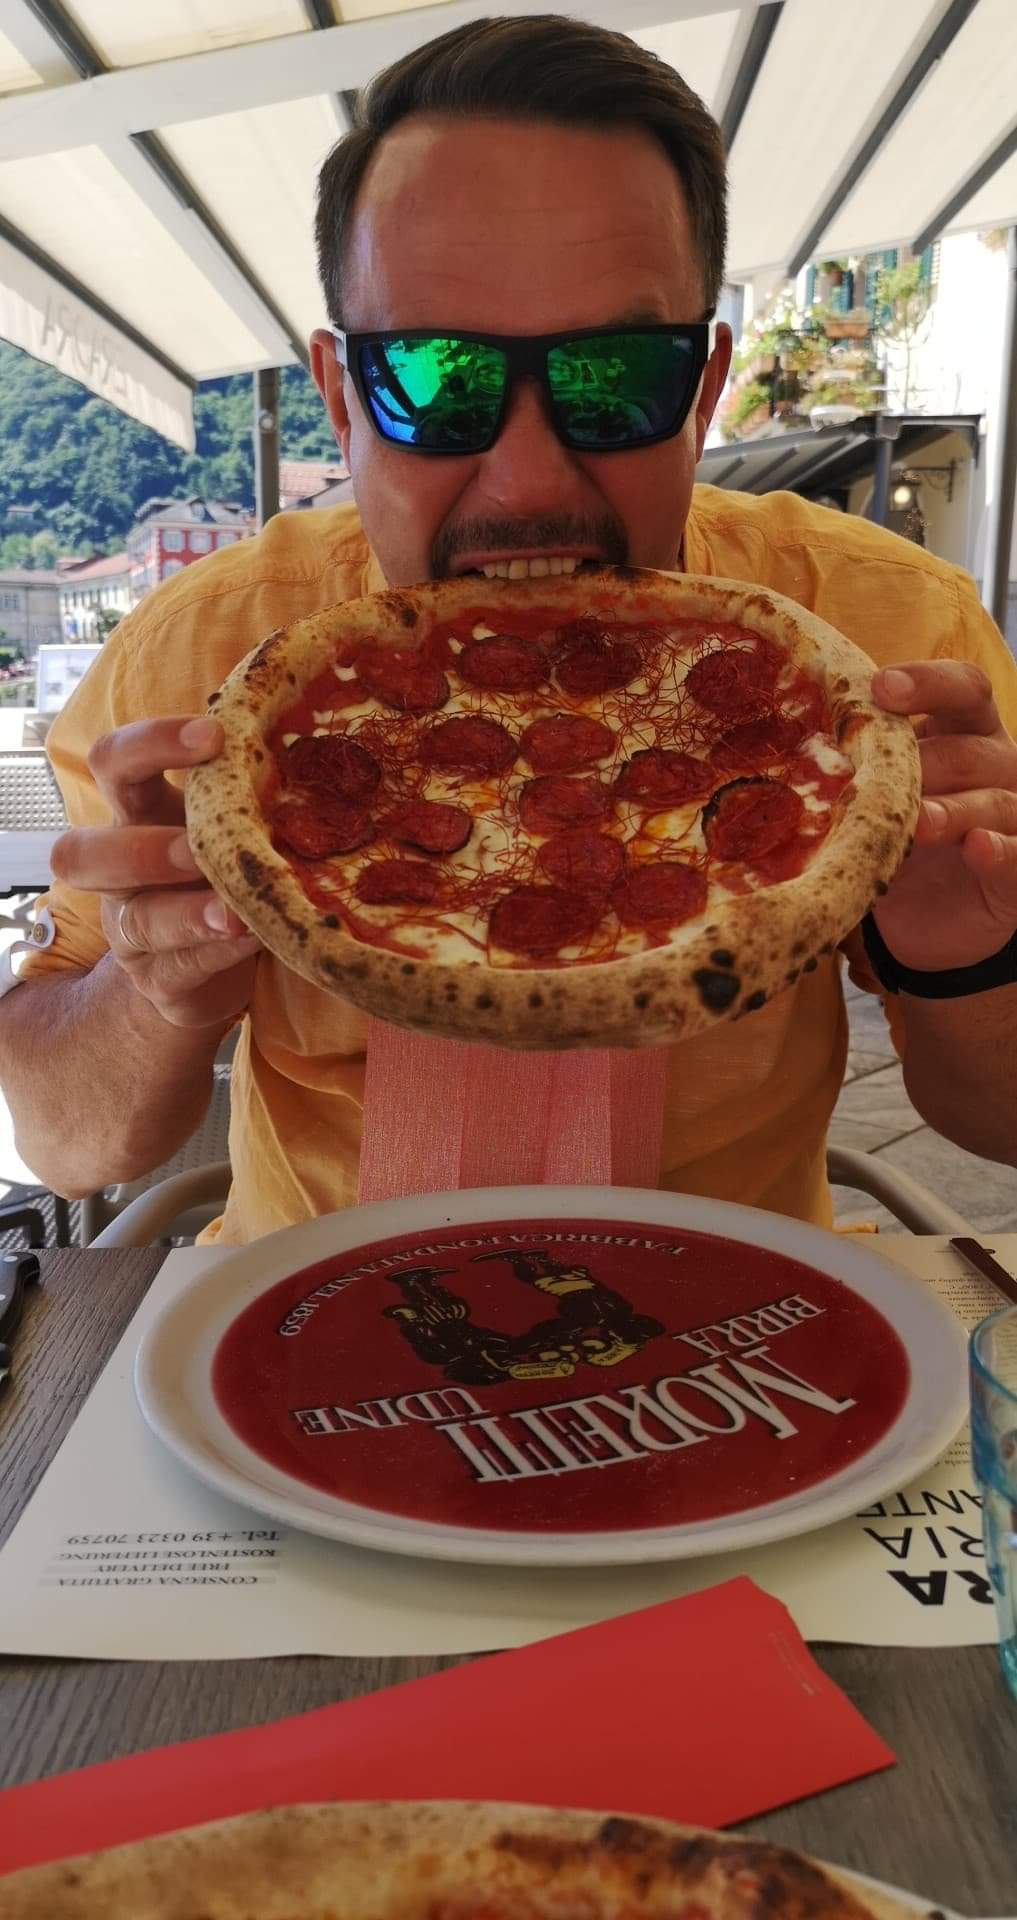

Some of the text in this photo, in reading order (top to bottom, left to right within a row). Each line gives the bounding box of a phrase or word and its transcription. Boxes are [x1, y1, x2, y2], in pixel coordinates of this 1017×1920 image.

[279, 1232, 688, 1337] FABBRICA FONDATA NEL 1859
[672, 1294, 827, 1358] BIRRA
[294, 1387, 490, 1436] UDINE
[435, 1345, 857, 1483] MORETTI
[66, 1530, 280, 1545] Tel. +39 0323 70759
[60, 1549, 276, 1560] KOSTENLOSE LIEFERUNG
[96, 1562, 231, 1573] FREE DELIVERY
[59, 1575, 260, 1587] CONSEGNA GRATUITA
